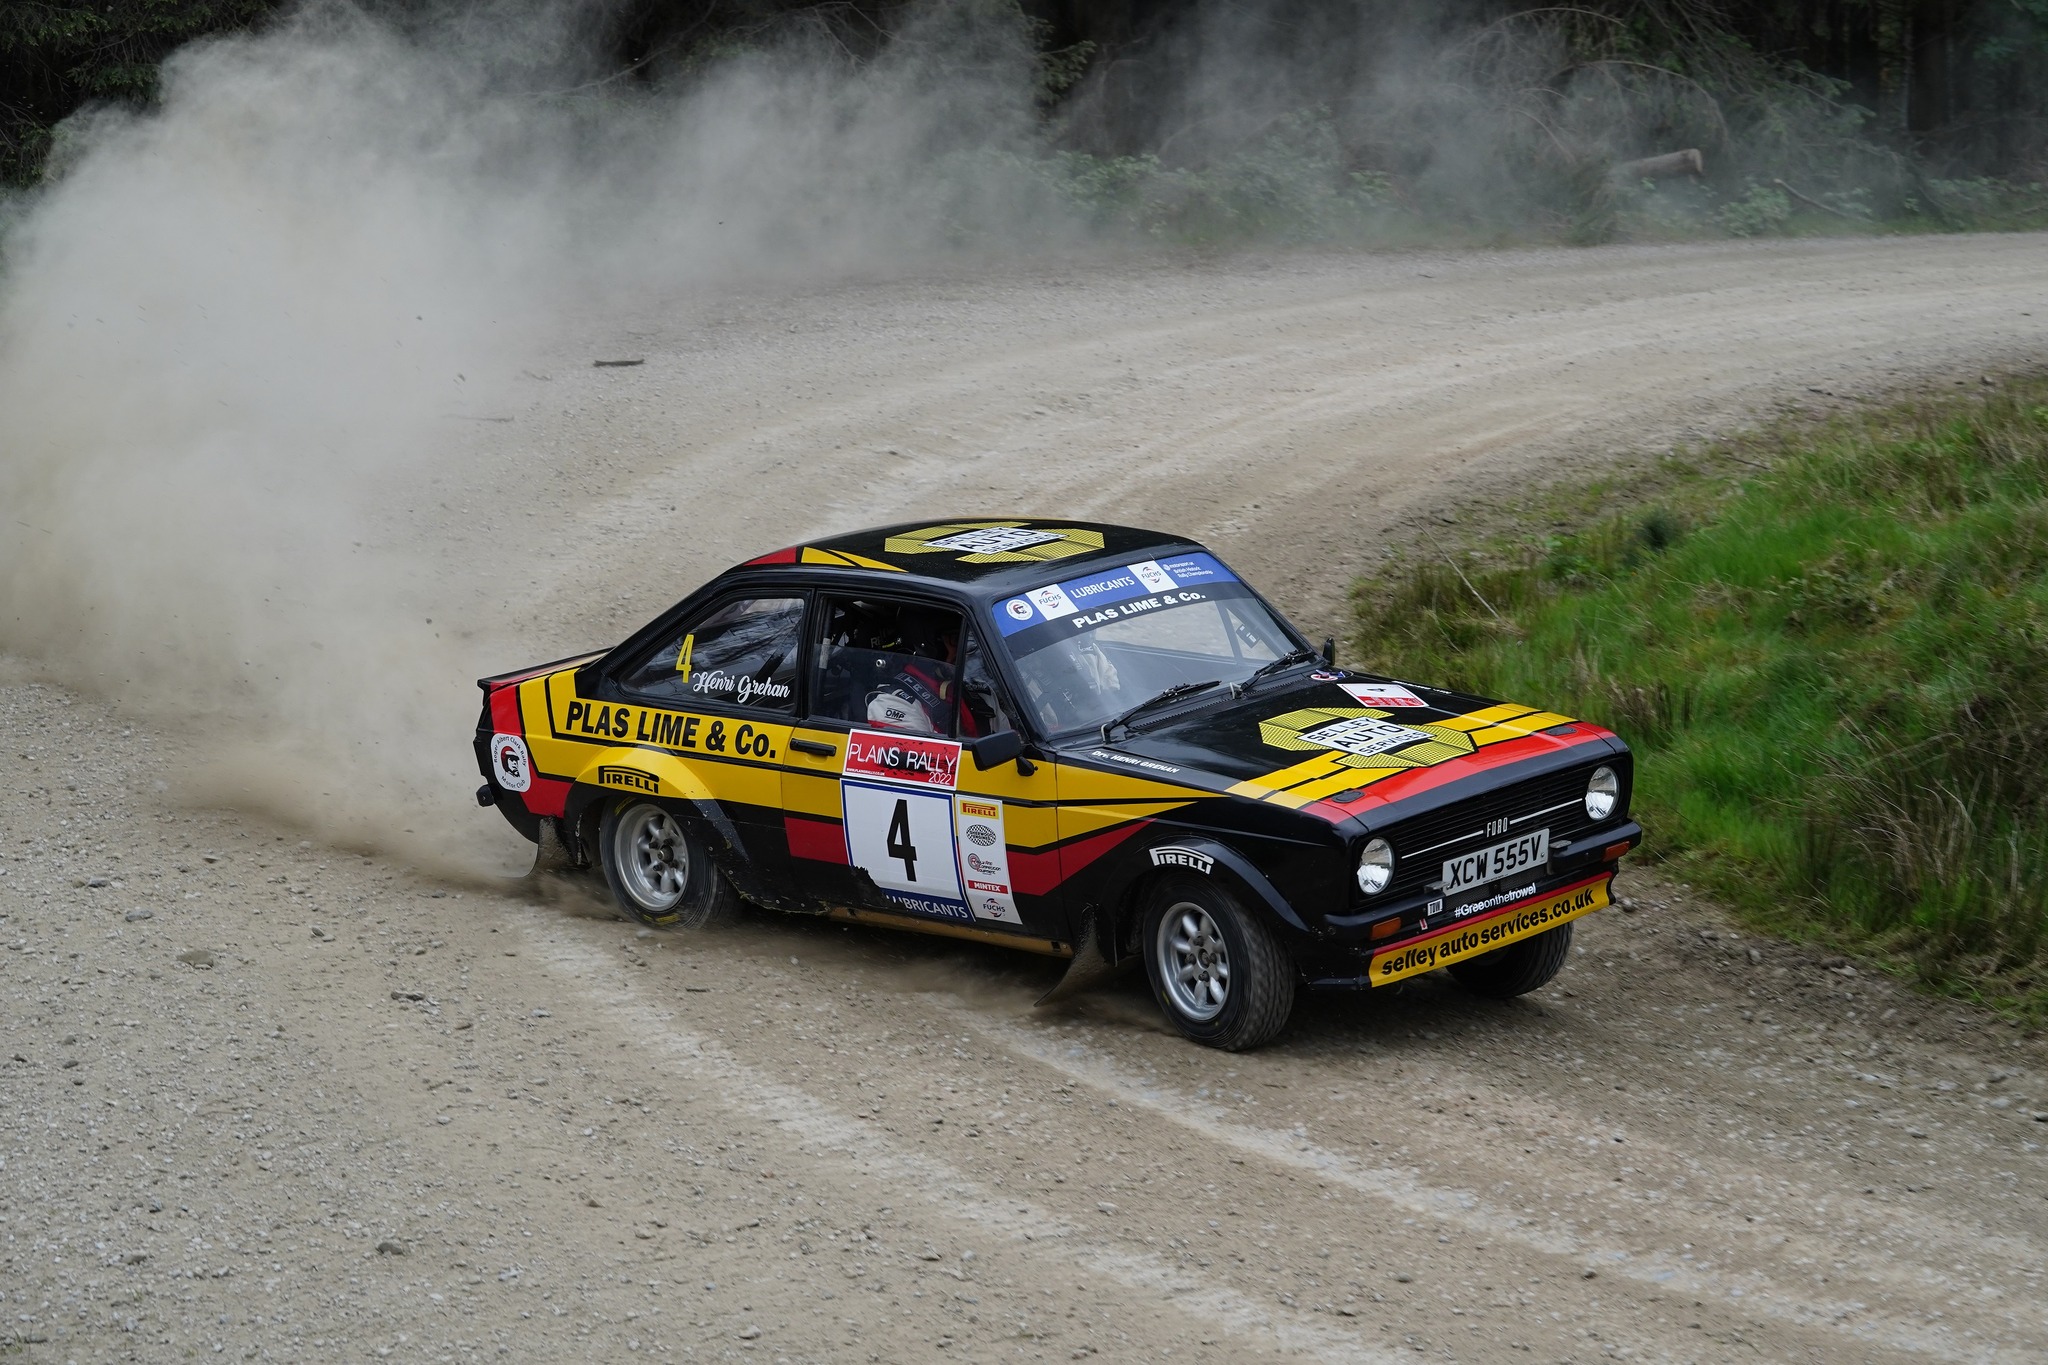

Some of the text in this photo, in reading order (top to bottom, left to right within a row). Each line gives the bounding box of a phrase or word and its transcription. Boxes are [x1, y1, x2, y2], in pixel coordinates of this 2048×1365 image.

[959, 531, 1037, 549] AUTO
[1141, 570, 1161, 579] FUCHS
[1039, 593, 1062, 605] FUCHS
[1070, 577, 1135, 599] LUBRICANTS
[1072, 592, 1206, 628] PLAS LIME & Co.
[675, 634, 694, 683] 4
[692, 670, 790, 704] Henri Grehan
[886, 709, 905, 719] OMP
[566, 701, 776, 759] PLAS LIME & Co.
[1307, 717, 1376, 742] SELLEY
[1333, 724, 1405, 749] AUTO
[1359, 731, 1428, 754] SERVICES
[848, 743, 956, 774] PLAINS RALLY
[1110, 755, 1141, 765] HENRI
[598, 765, 660, 794] PIRELLI
[928, 772, 951, 785] 2022
[962, 802, 996, 817] PIRELLI
[886, 798, 917, 882] 4
[1149, 846, 1214, 875] PIRELLI
[1450, 834, 1542, 889] XCW 555V
[973, 882, 1000, 892] MINTEX
[887, 895, 968, 919] BRICANTS
[983, 904, 1005, 912] FUCHS
[1381, 888, 1594, 975] selley auto services.co.uk
